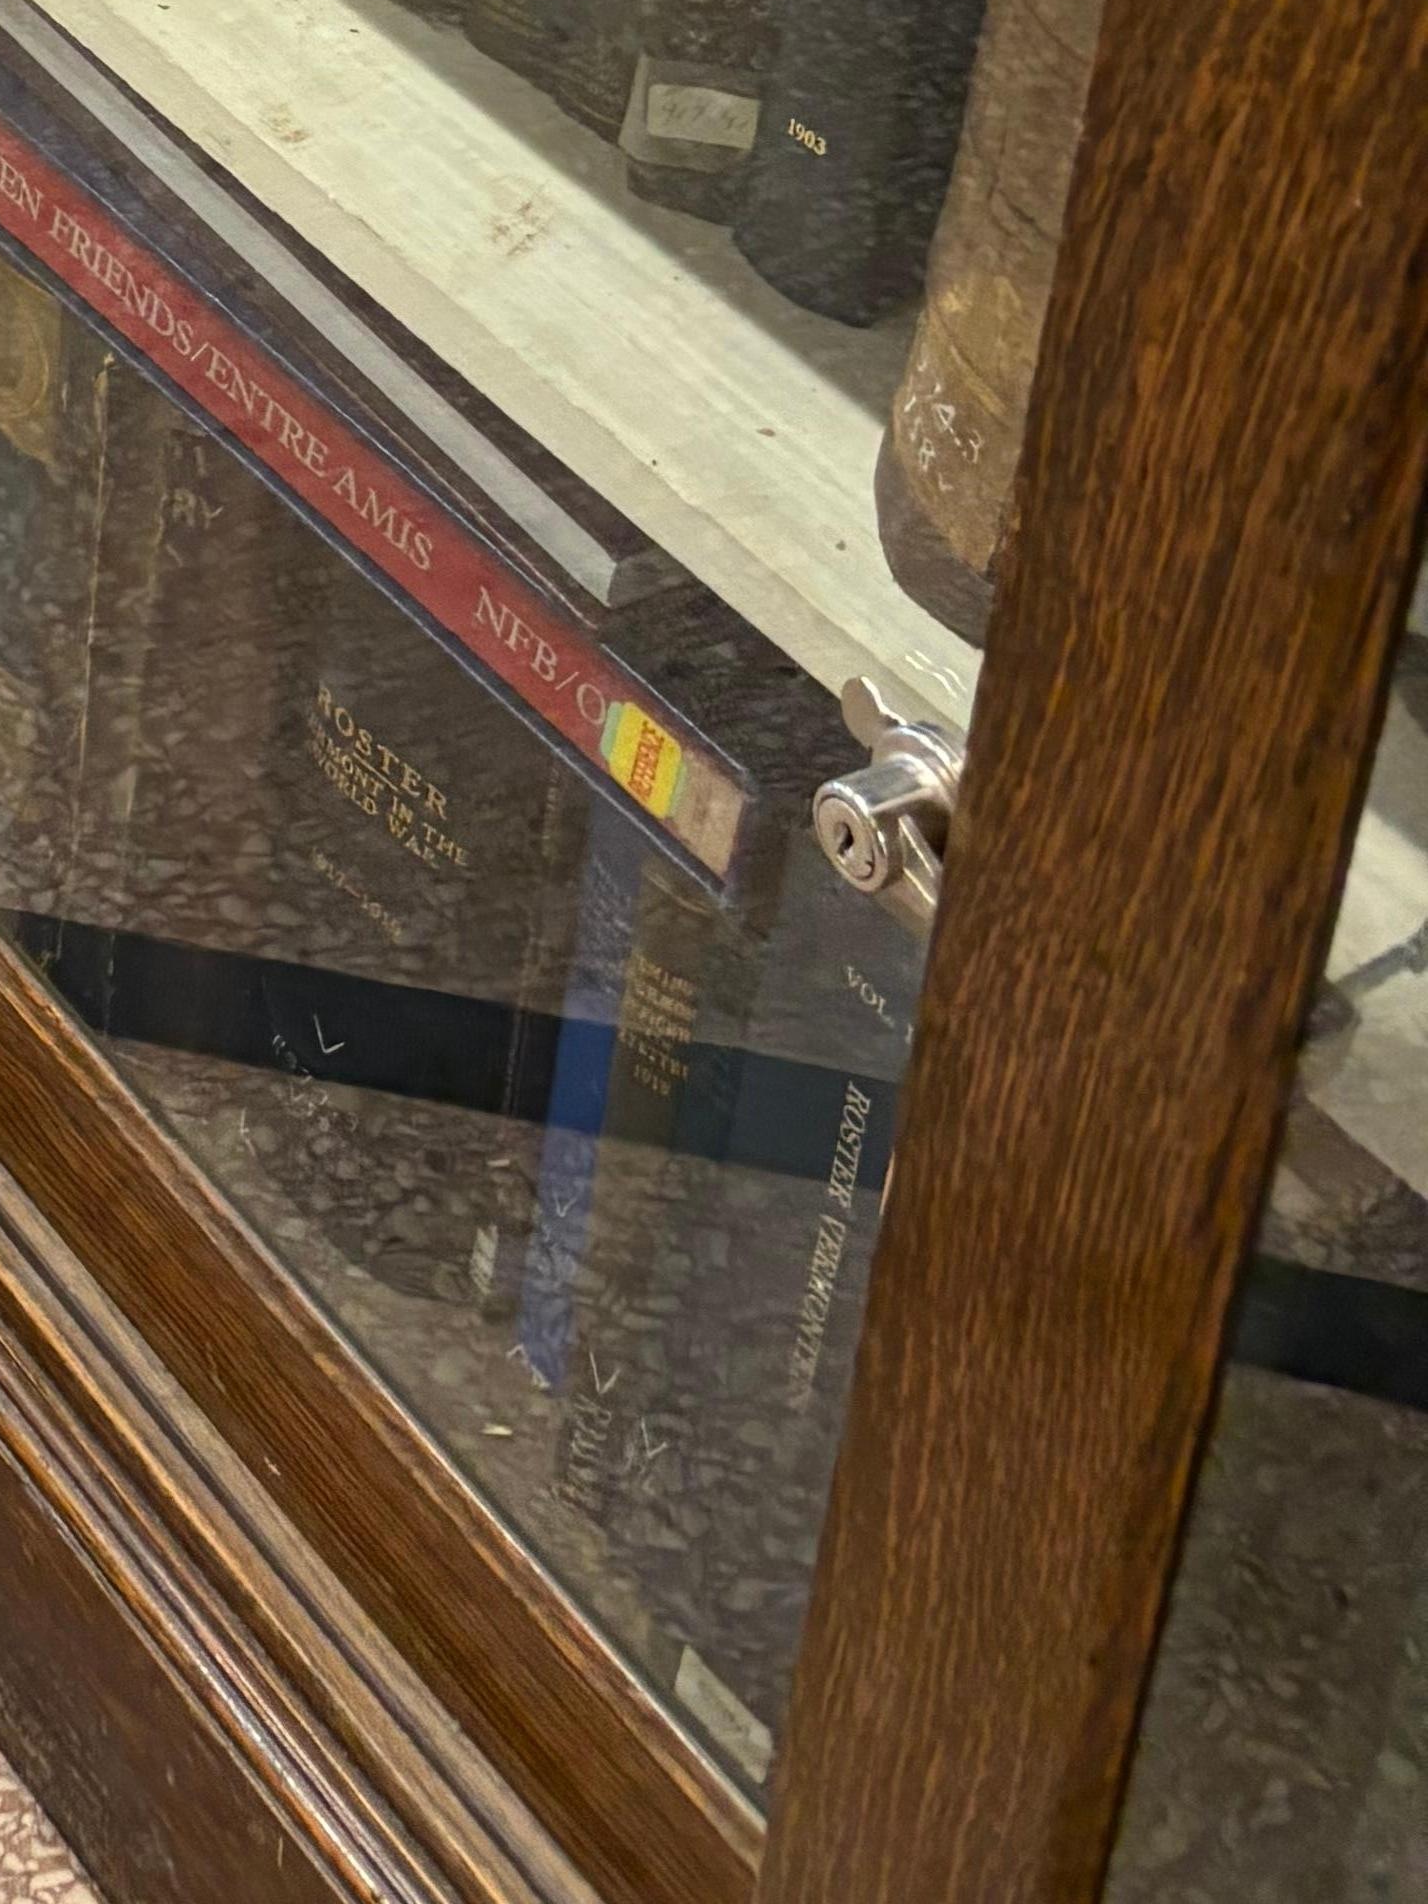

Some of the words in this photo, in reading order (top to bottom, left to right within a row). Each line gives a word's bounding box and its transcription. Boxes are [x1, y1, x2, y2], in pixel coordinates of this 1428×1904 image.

[787, 118, 827, 157] 1903
[48, 208, 330, 480] FRIENDS/ENTRE
[332, 463, 436, 573] AMIS
[471, 584, 607, 726] NFB/O
[317, 681, 448, 821] ROSTER
[421, 821, 469, 867] THE
[828, 1080, 871, 1210] ROSTER
